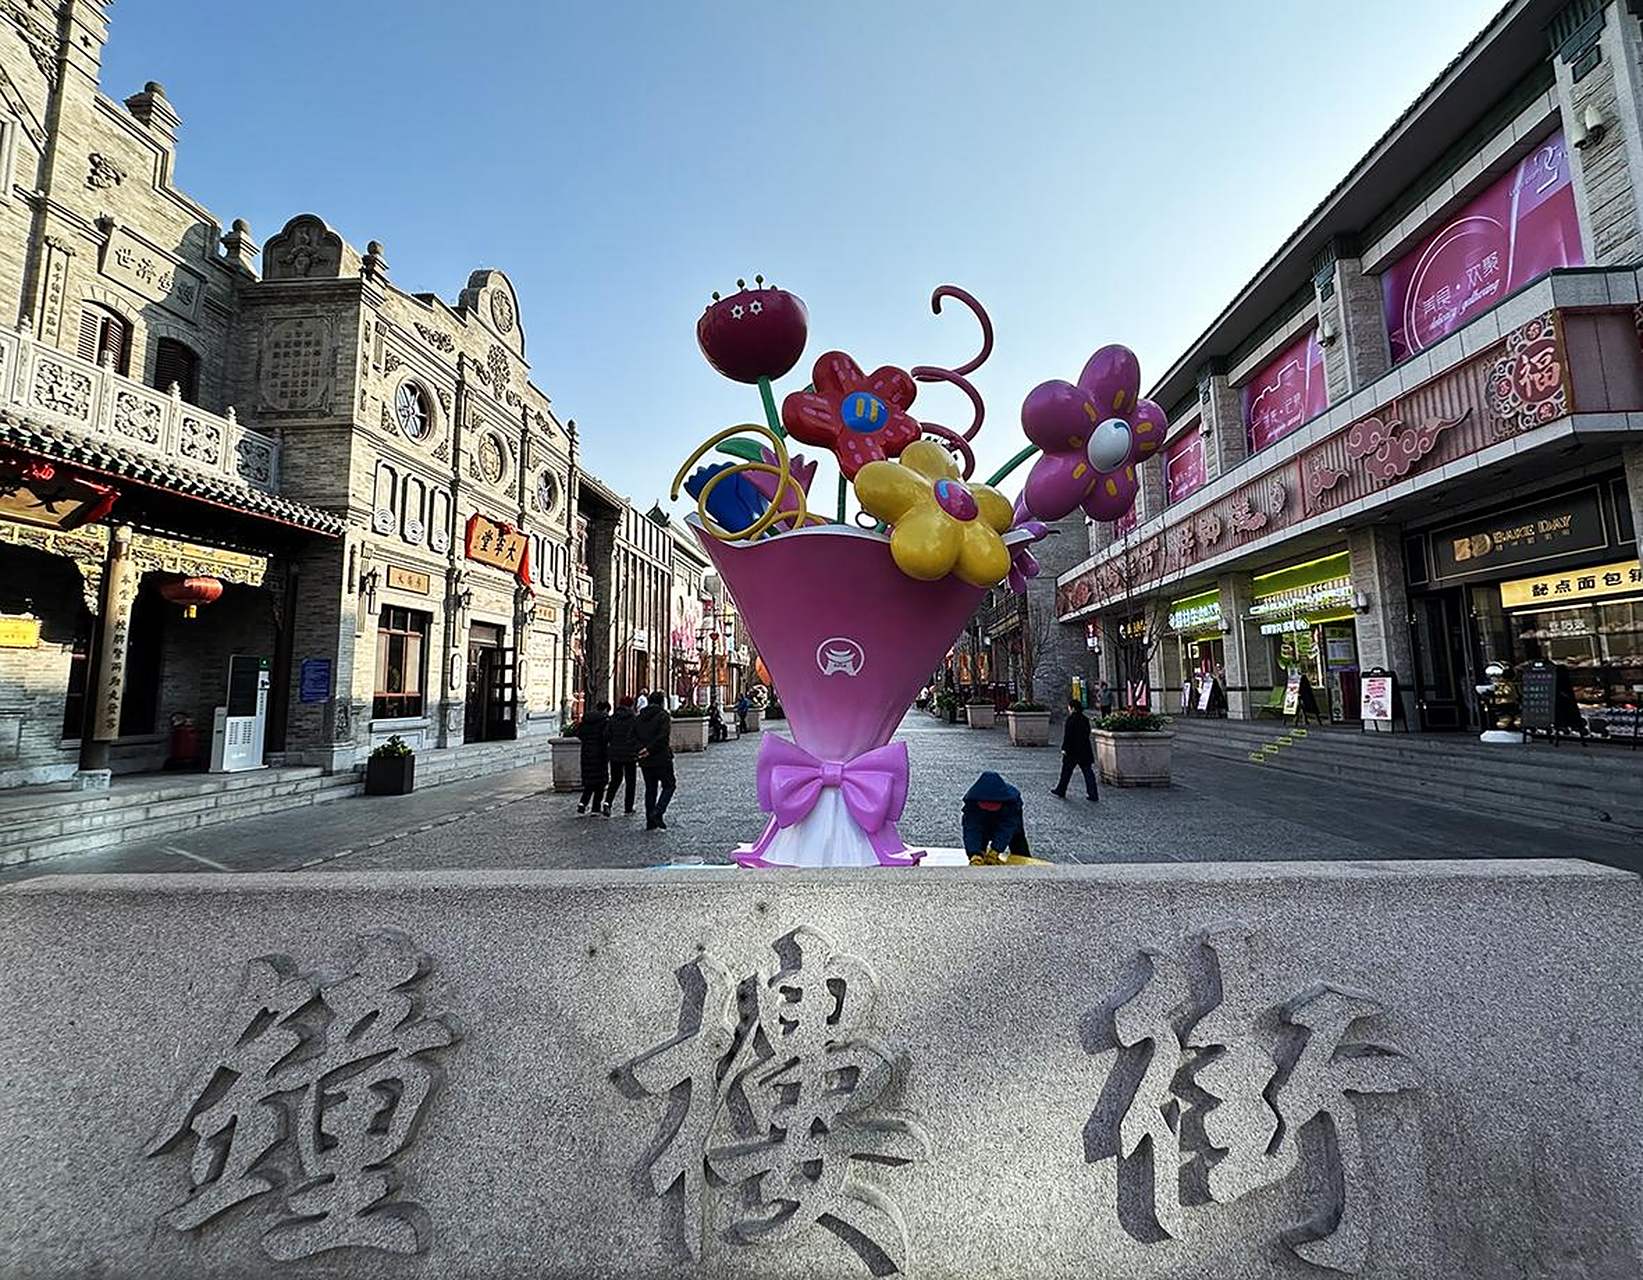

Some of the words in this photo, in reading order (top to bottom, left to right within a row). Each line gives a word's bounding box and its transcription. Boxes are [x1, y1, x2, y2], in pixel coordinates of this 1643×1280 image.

[1518, 347, 1560, 398] 福
[1492, 523, 1535, 544] BAKE
[1538, 515, 1572, 534] DAY
